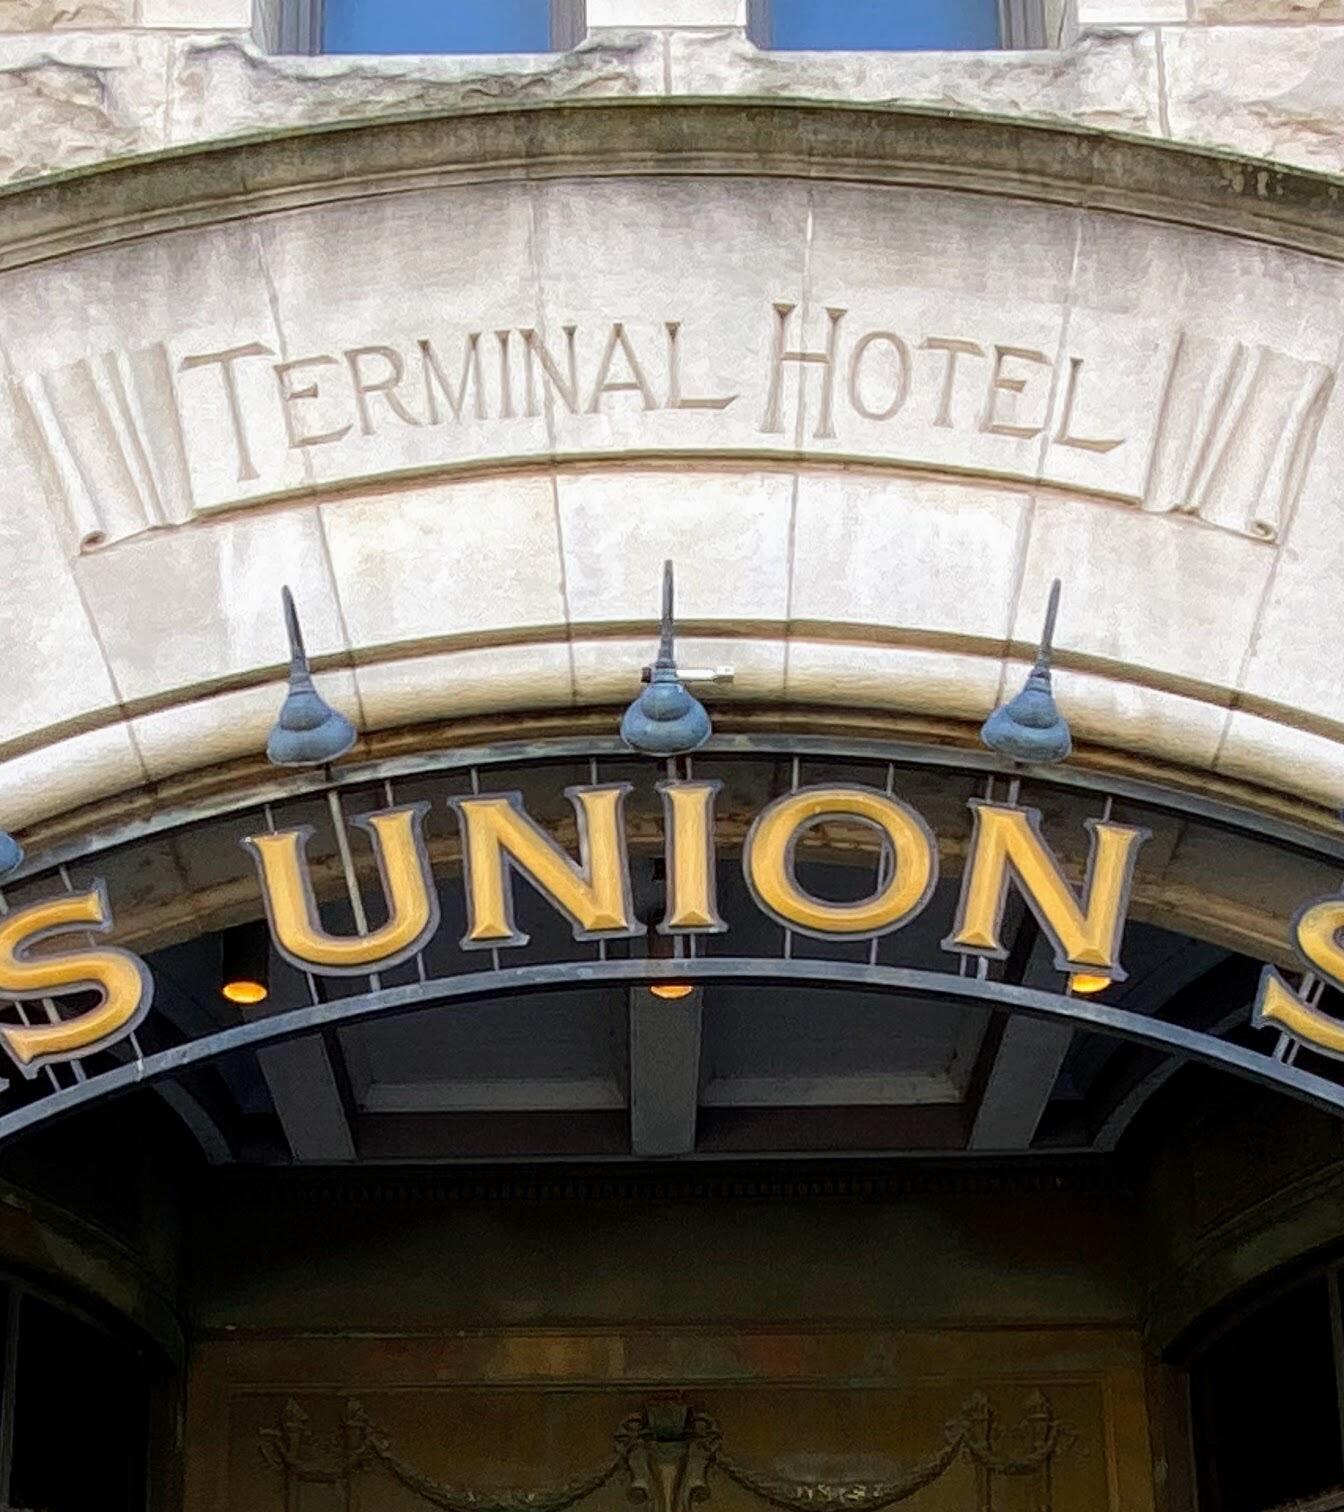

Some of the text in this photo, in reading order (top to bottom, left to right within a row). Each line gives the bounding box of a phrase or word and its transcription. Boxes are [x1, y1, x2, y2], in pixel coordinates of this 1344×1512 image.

[179, 302, 1125, 482] TERMINAL HOTEL
[239, 780, 1153, 982] UNION
